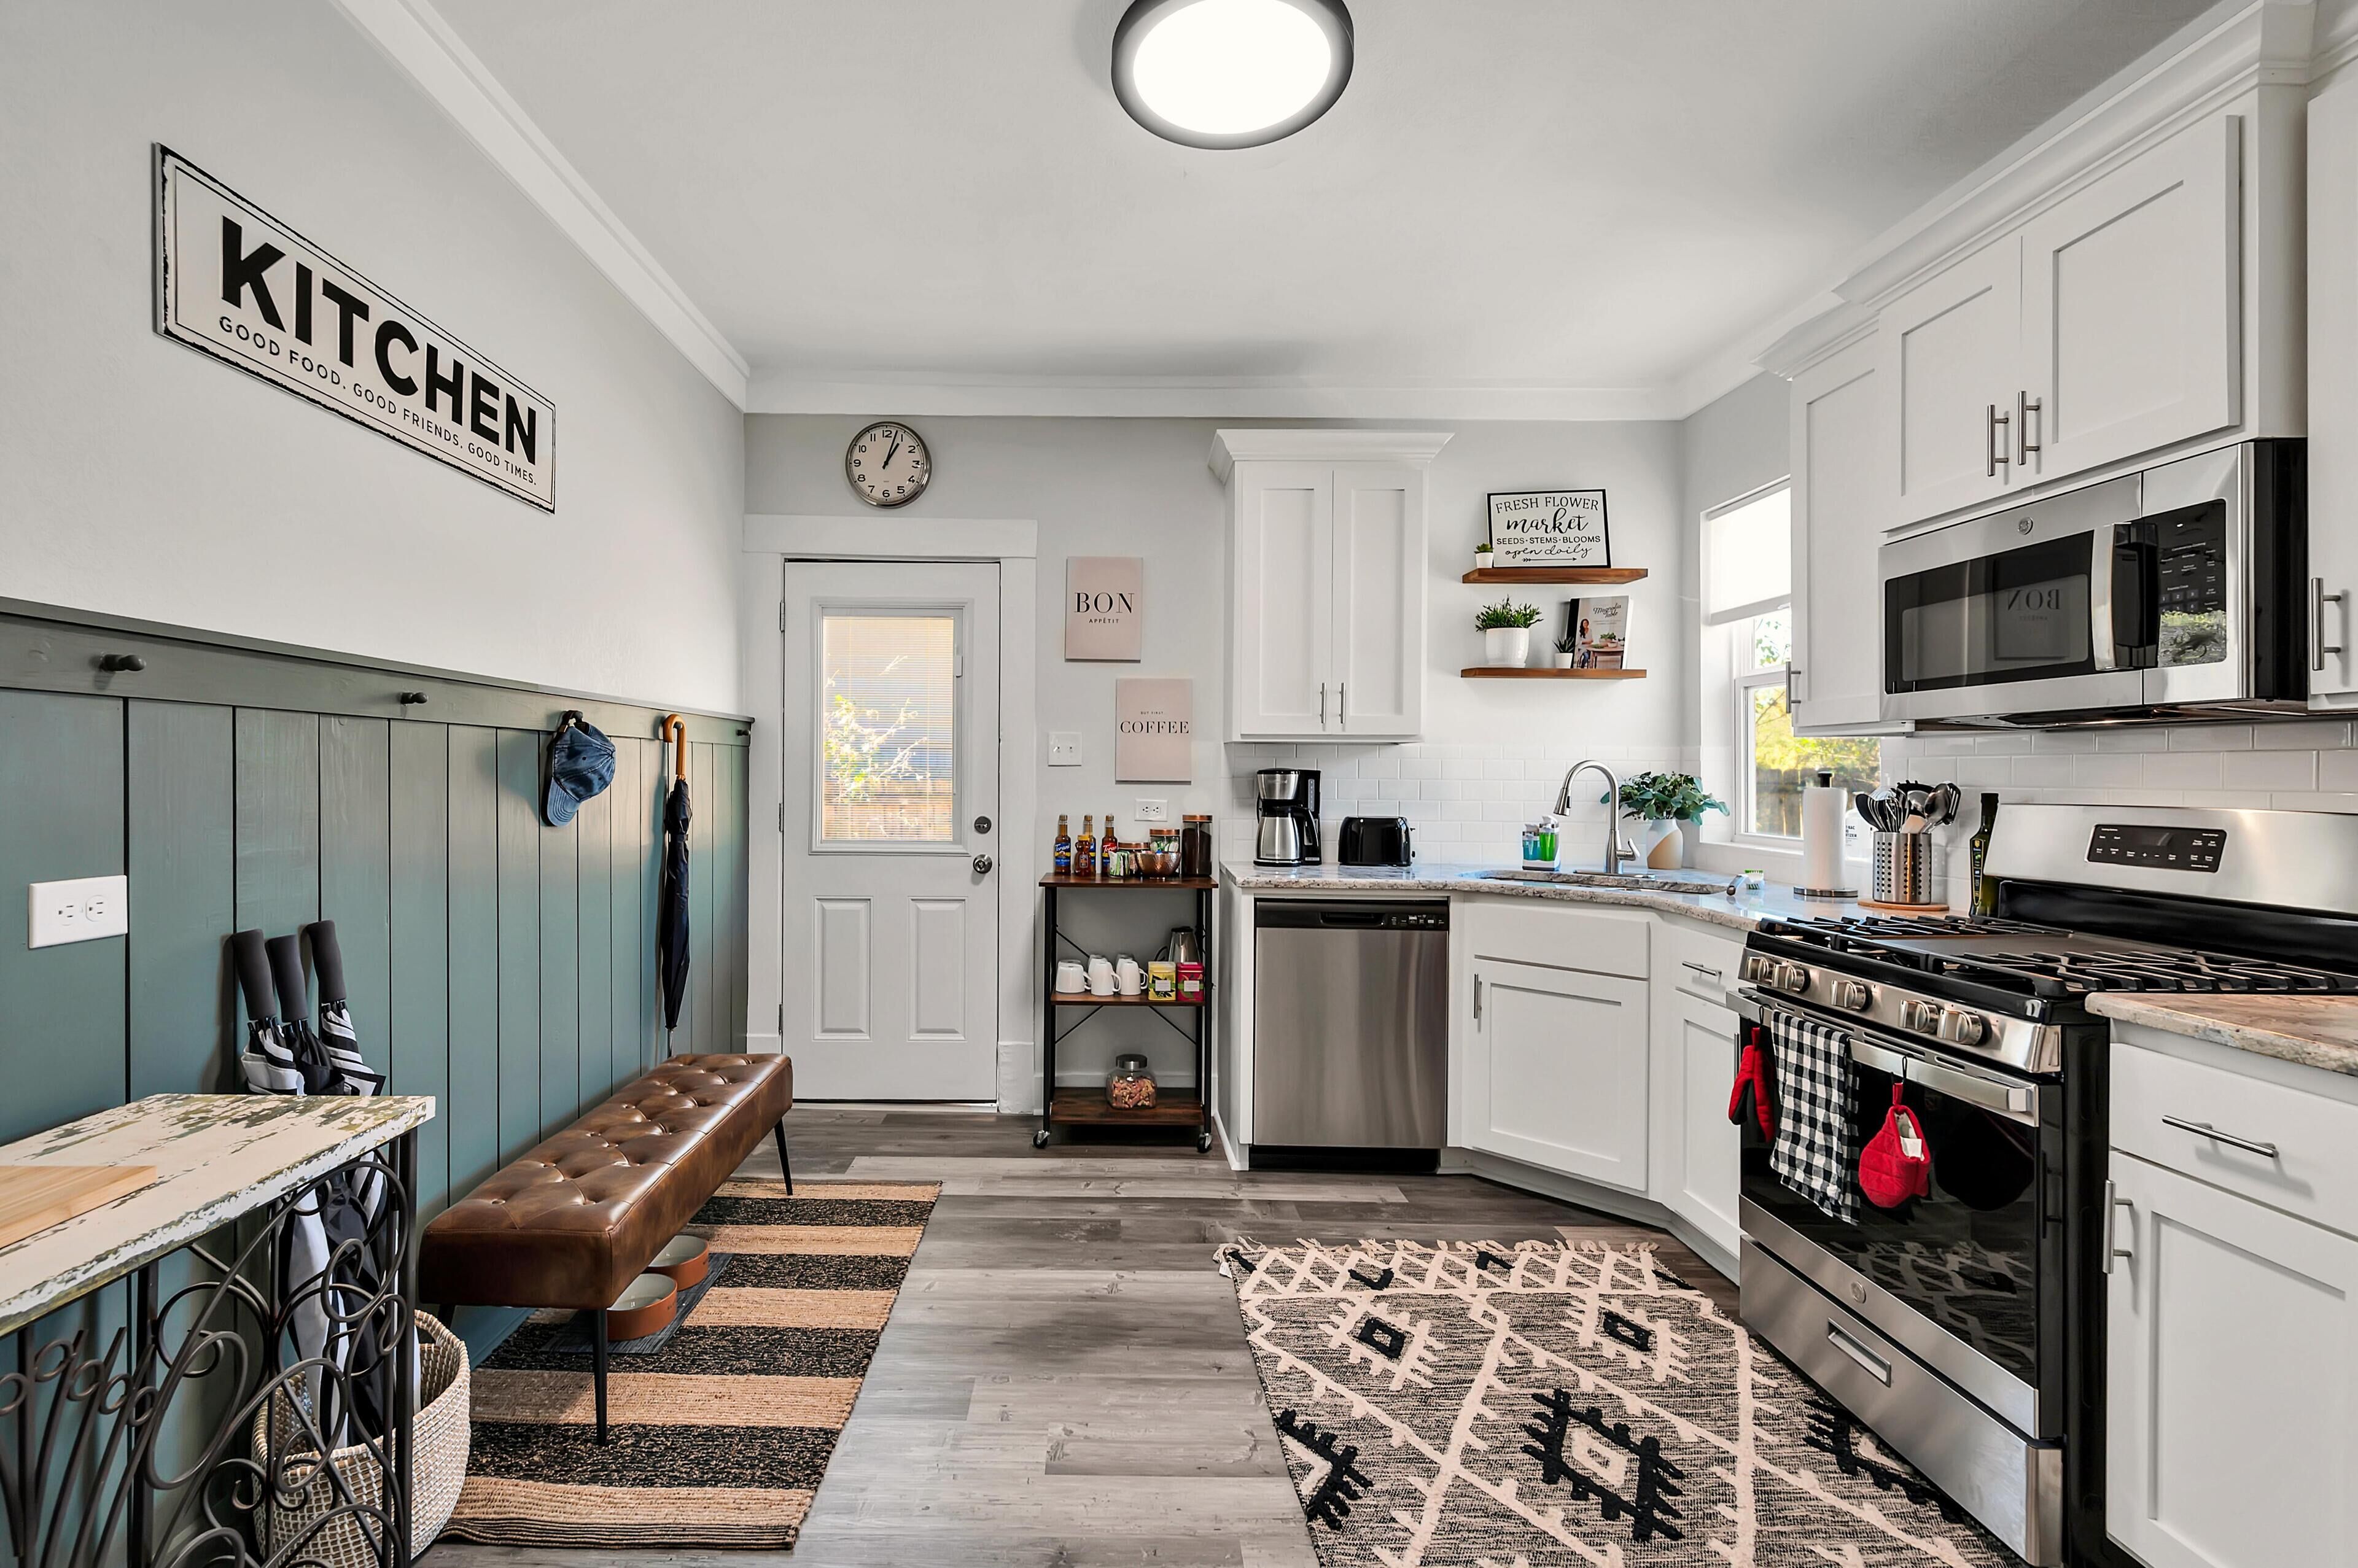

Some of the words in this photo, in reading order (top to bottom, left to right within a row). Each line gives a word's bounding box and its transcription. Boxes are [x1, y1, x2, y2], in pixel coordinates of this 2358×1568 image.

[221, 215, 536, 465] KITCHEN
[219, 316, 280, 355] GOOD
[289, 349, 346, 389] FOOD.
[353, 383, 396, 414] GOOD
[403, 408, 463, 449] FRIENDS.
[468, 443, 500, 466] GOOD
[505, 460, 537, 485] TIMES.
[870, 433, 876, 442] 11
[908, 445, 916, 454] 2
[1496, 497, 1539, 514] FRESH
[1545, 496, 1598, 511] FLOWER
[1506, 507, 1589, 534] market
[1505, 548, 1543, 559] open
[1544, 543, 1592, 558] daily
[1074, 592, 1135, 613] BON
[1120, 721, 1189, 734] COFFEE
[1055, 843, 1070, 852] Torani
[1103, 844, 1117, 855] Toran
